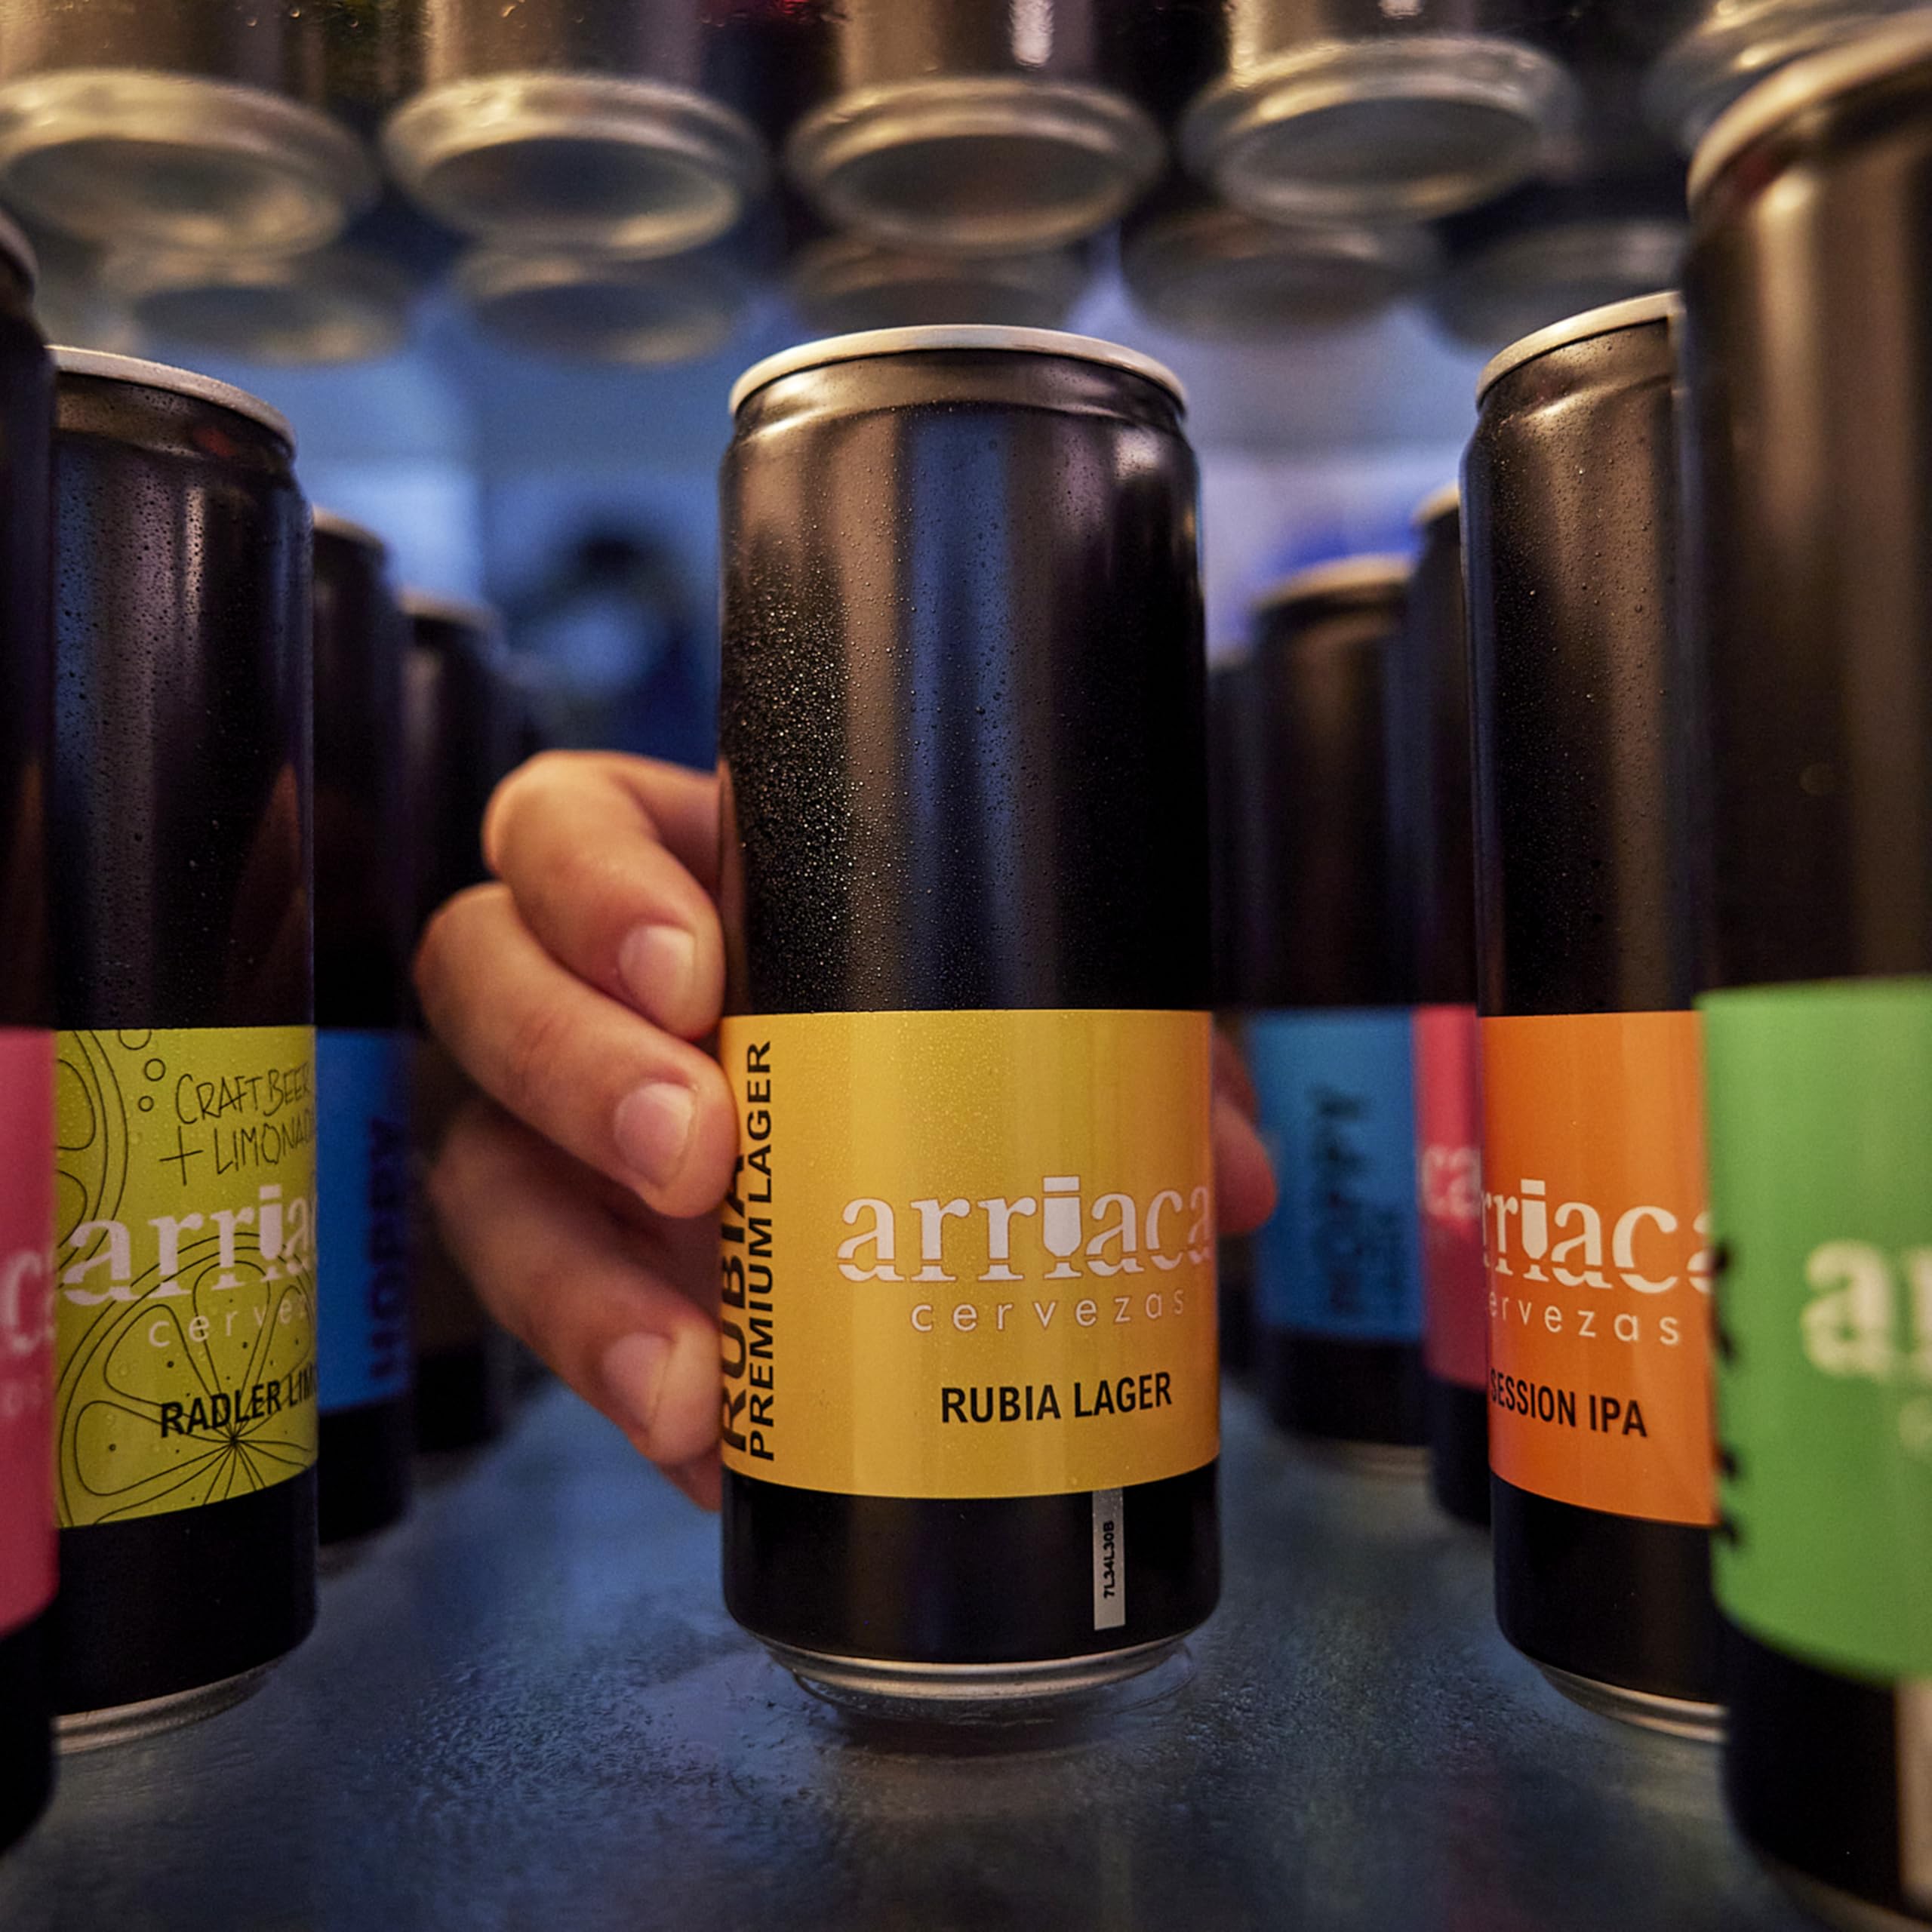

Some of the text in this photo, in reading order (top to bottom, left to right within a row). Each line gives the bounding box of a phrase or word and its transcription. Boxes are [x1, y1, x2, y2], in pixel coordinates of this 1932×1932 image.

[176, 1074, 263, 1124] CRAFT
[746, 1041, 774, 1461] PREMIUM LAGER
[836, 1175, 1212, 1283] arriaca
[721, 1154, 747, 1453] RUBIA
[910, 1289, 1184, 1333] cervezas
[161, 1380, 281, 1438] RADLER
[941, 1371, 1172, 1424] RUBIA LAGER
[1490, 1367, 1648, 1438] SESSION IPA
